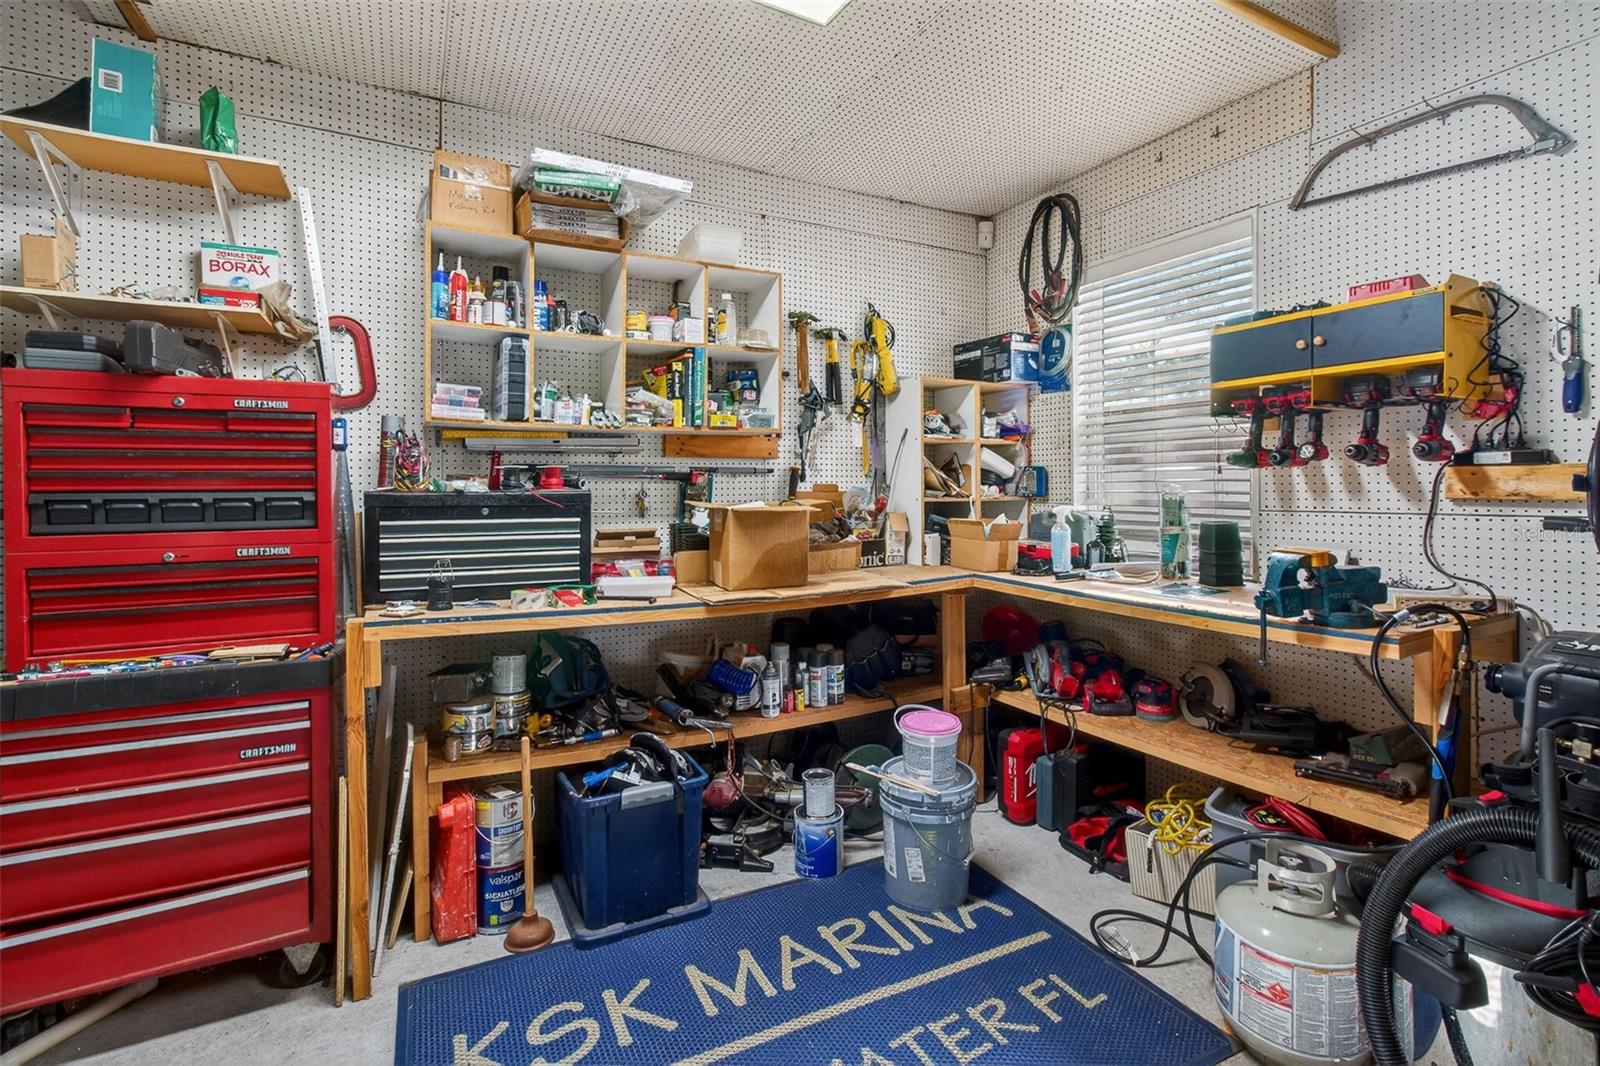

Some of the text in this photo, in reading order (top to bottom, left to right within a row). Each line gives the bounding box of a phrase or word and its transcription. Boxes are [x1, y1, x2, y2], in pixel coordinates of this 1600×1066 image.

[209, 259, 271, 279] BORAX
[234, 399, 289, 409] CRAFTSMAN
[237, 546, 291, 557] CRAFTSMAN
[240, 743, 297, 759] CRAFTSMAN
[452, 899, 1014, 1066] KSK MARINA
[1018, 974, 1108, 1023] FL
